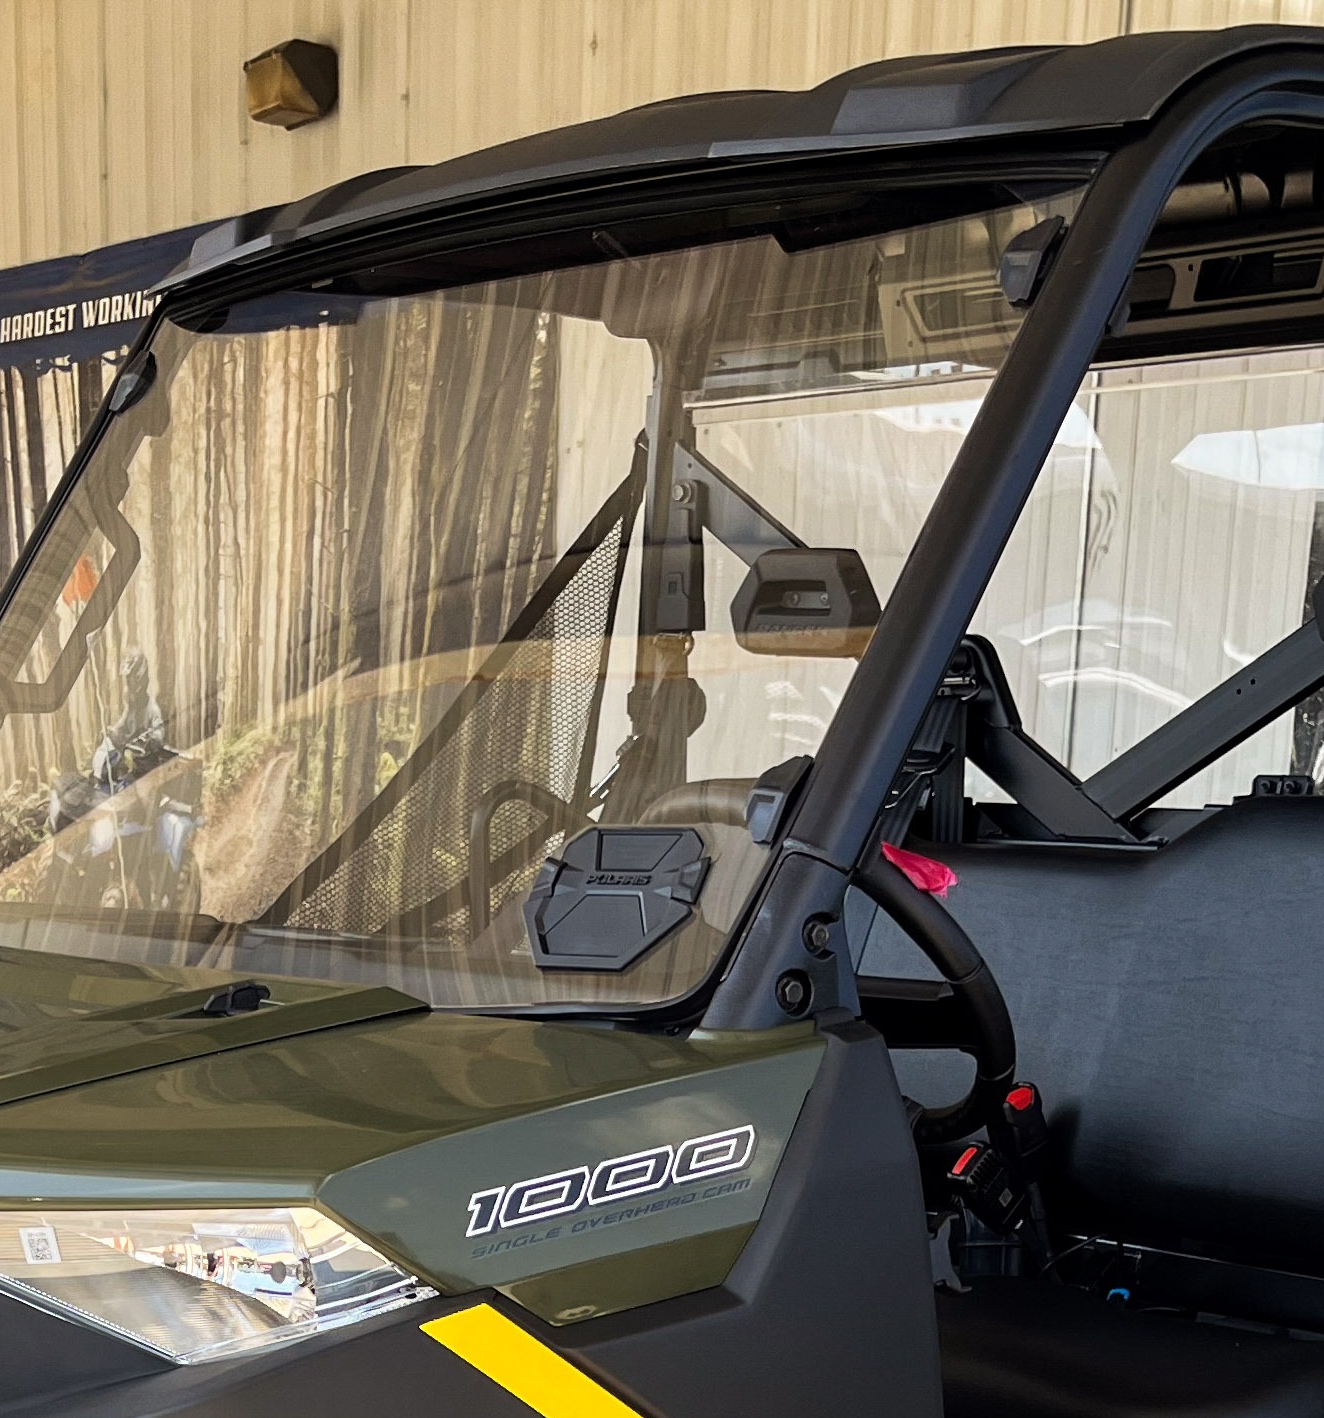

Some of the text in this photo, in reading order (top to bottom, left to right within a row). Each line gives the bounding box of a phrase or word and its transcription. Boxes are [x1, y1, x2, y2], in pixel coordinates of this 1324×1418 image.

[0, 304, 78, 343] HARDEST
[586, 873, 653, 885] POLARIS
[465, 1124, 759, 1238] 1000
[471, 1178, 753, 1259] SINGLE OVERHEAD CAM
